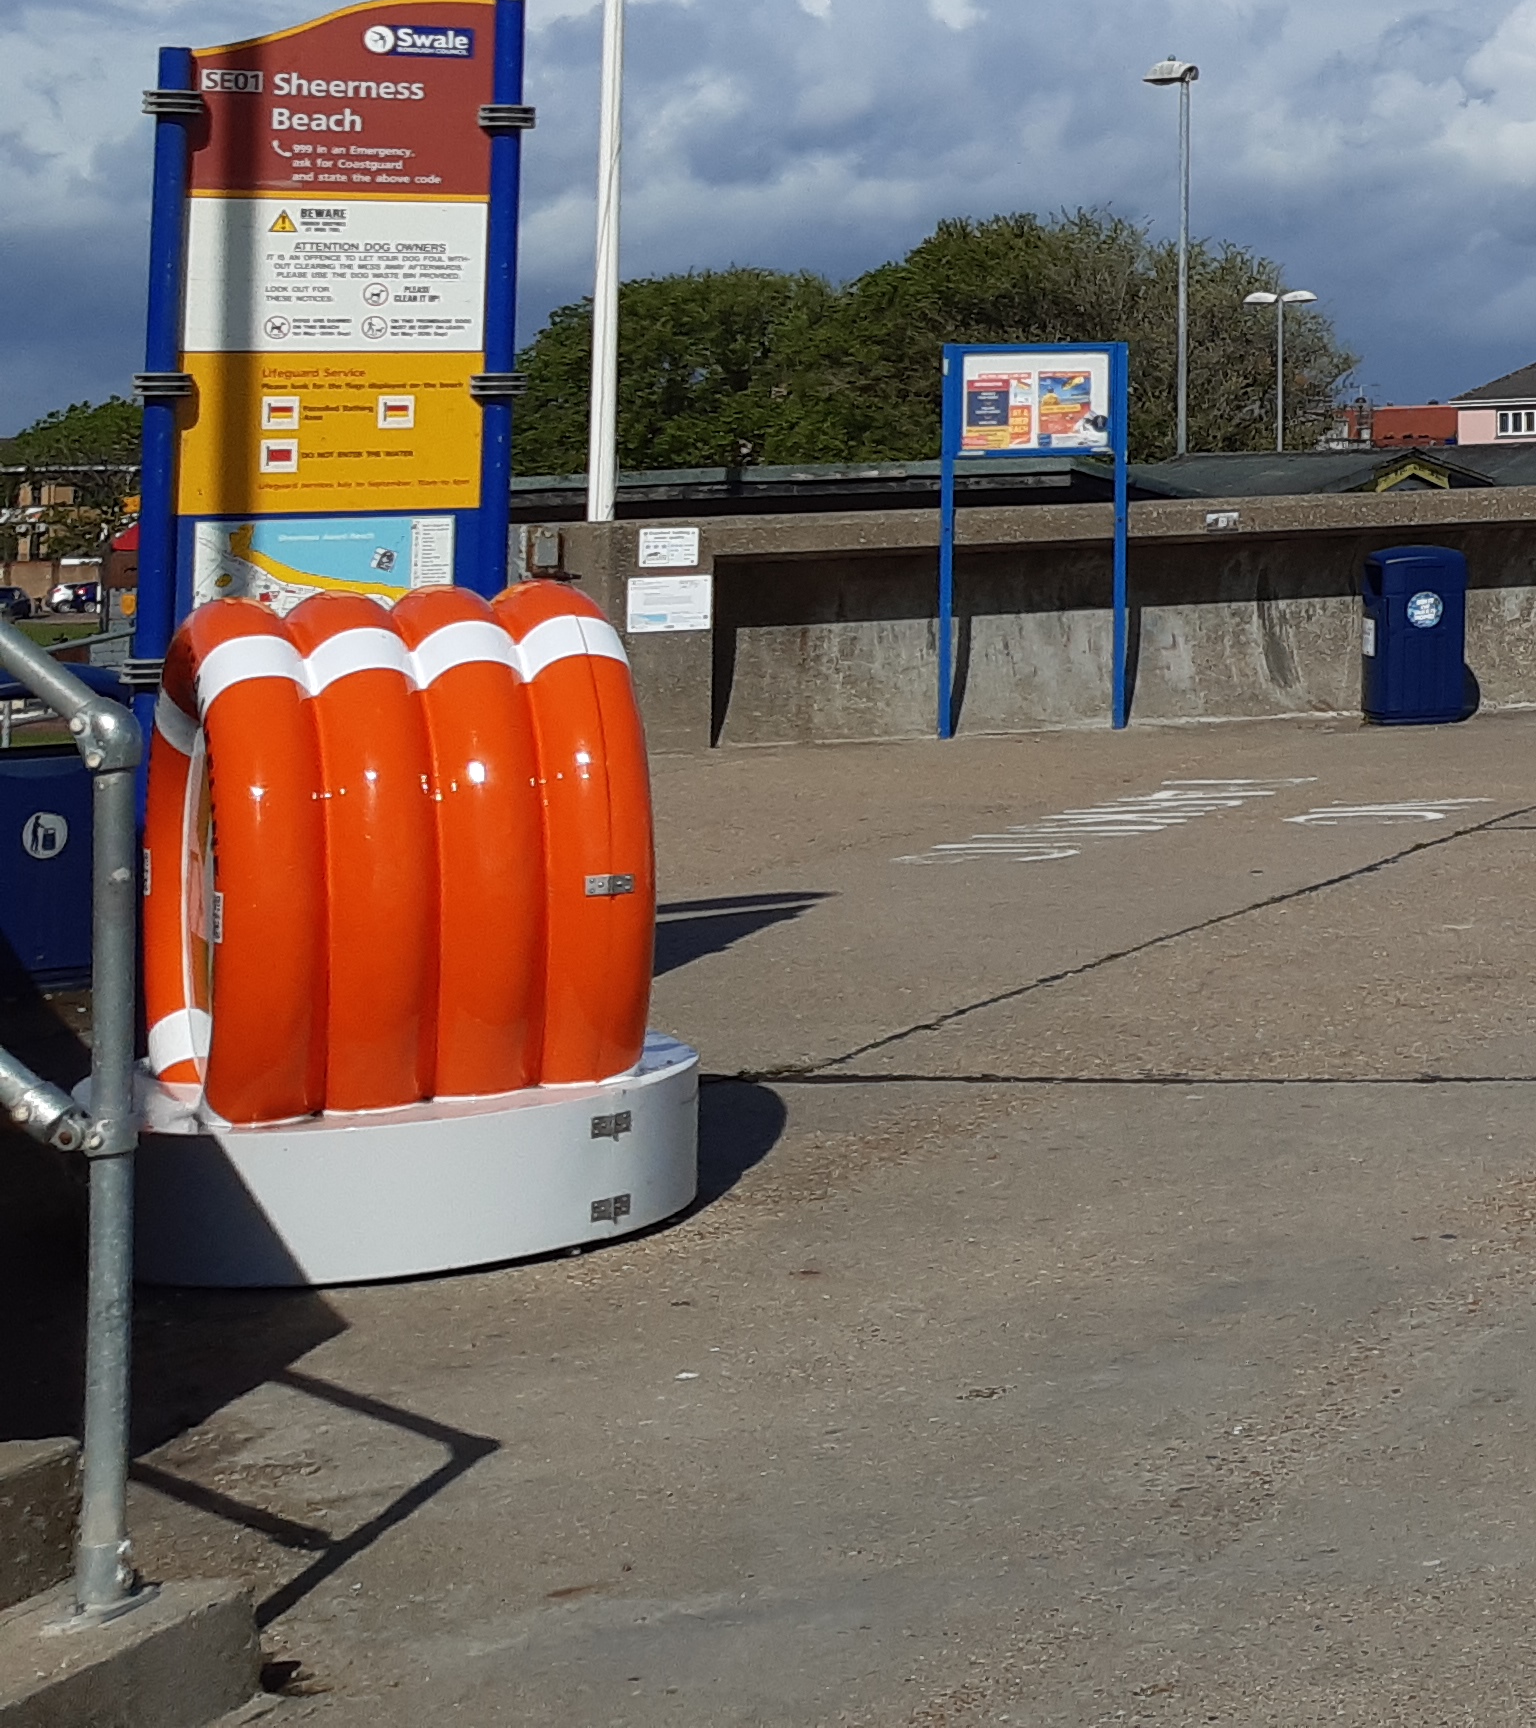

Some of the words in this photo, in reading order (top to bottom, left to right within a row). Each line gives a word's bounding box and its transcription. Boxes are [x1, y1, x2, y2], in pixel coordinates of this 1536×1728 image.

[396, 28, 469, 50] Swale
[205, 71, 260, 91] SE01
[273, 73, 425, 100] Sheerness
[271, 107, 363, 132] Beach
[292, 144, 313, 154] 999
[292, 158, 312, 168] ask
[316, 159, 333, 168] for
[337, 159, 404, 172] Coastguard
[292, 171, 314, 182] and
[317, 173, 348, 183] state
[352, 173, 371, 183] the
[375, 174, 410, 184] above
[414, 175, 442, 185] code
[300, 209, 347, 219] BEWARE
[294, 242, 360, 252] ATTENTION
[364, 243, 391, 252] DOG
[395, 243, 446, 253] OWNERS
[261, 368, 320, 380] Lifeguard
[323, 368, 367, 378] Service
